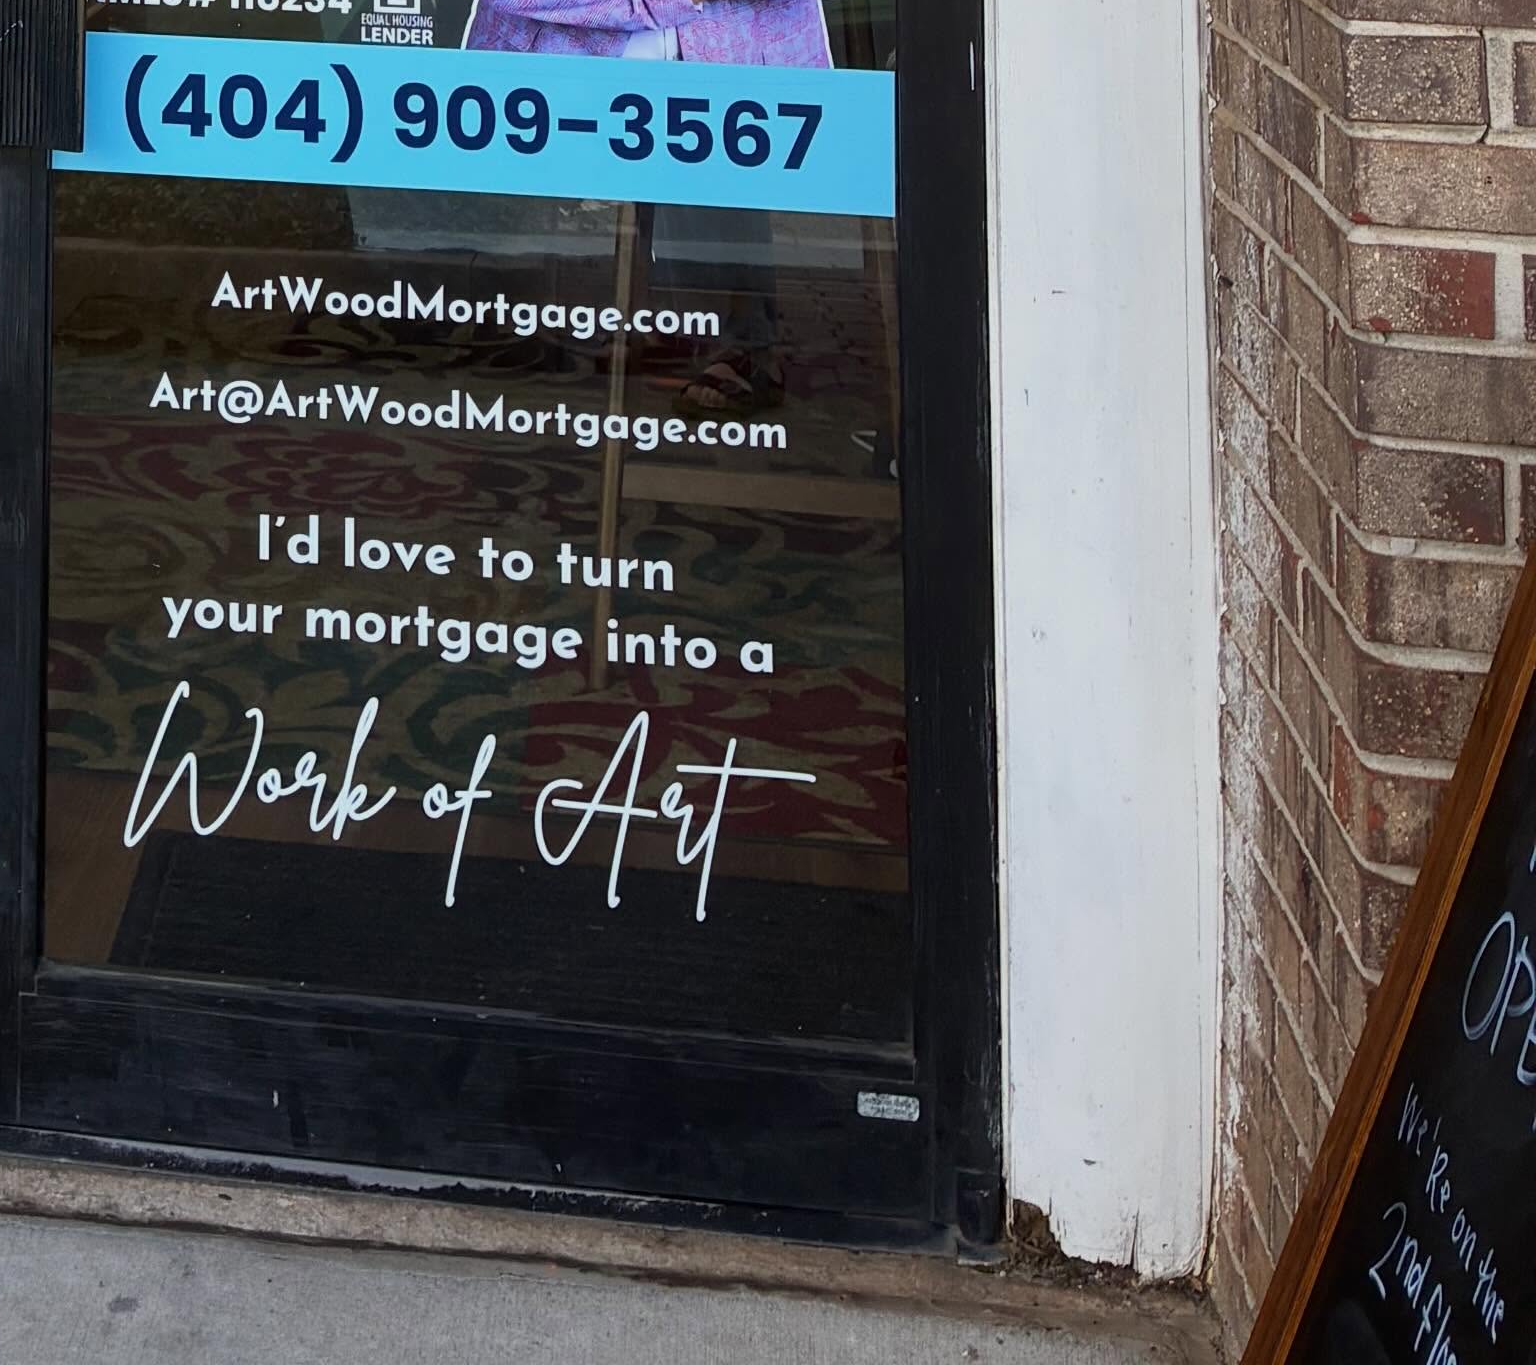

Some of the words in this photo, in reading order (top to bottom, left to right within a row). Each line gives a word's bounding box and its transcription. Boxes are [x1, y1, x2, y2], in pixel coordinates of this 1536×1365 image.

[361, 13, 391, 26] EQUAL
[392, 14, 433, 28] HOUSING
[361, 26, 433, 45] LENDER
[124, 54, 363, 163] (404)
[393, 82, 822, 171] 909-3567
[212, 272, 720, 339] ArtWoodMortgage.com
[149, 373, 787, 450] Art@ArtWoodMortgage.com
[258, 514, 320, 564] I'd
[344, 518, 455, 576] love
[479, 537, 533, 581] to
[557, 543, 674, 592] turn
[162, 594, 284, 638] your
[305, 606, 583, 667] mortgage
[606, 620, 718, 669] into
[739, 640, 774, 673] a
[124, 680, 397, 848] Work
[422, 734, 494, 908] of
[535, 711, 817, 922] Art
